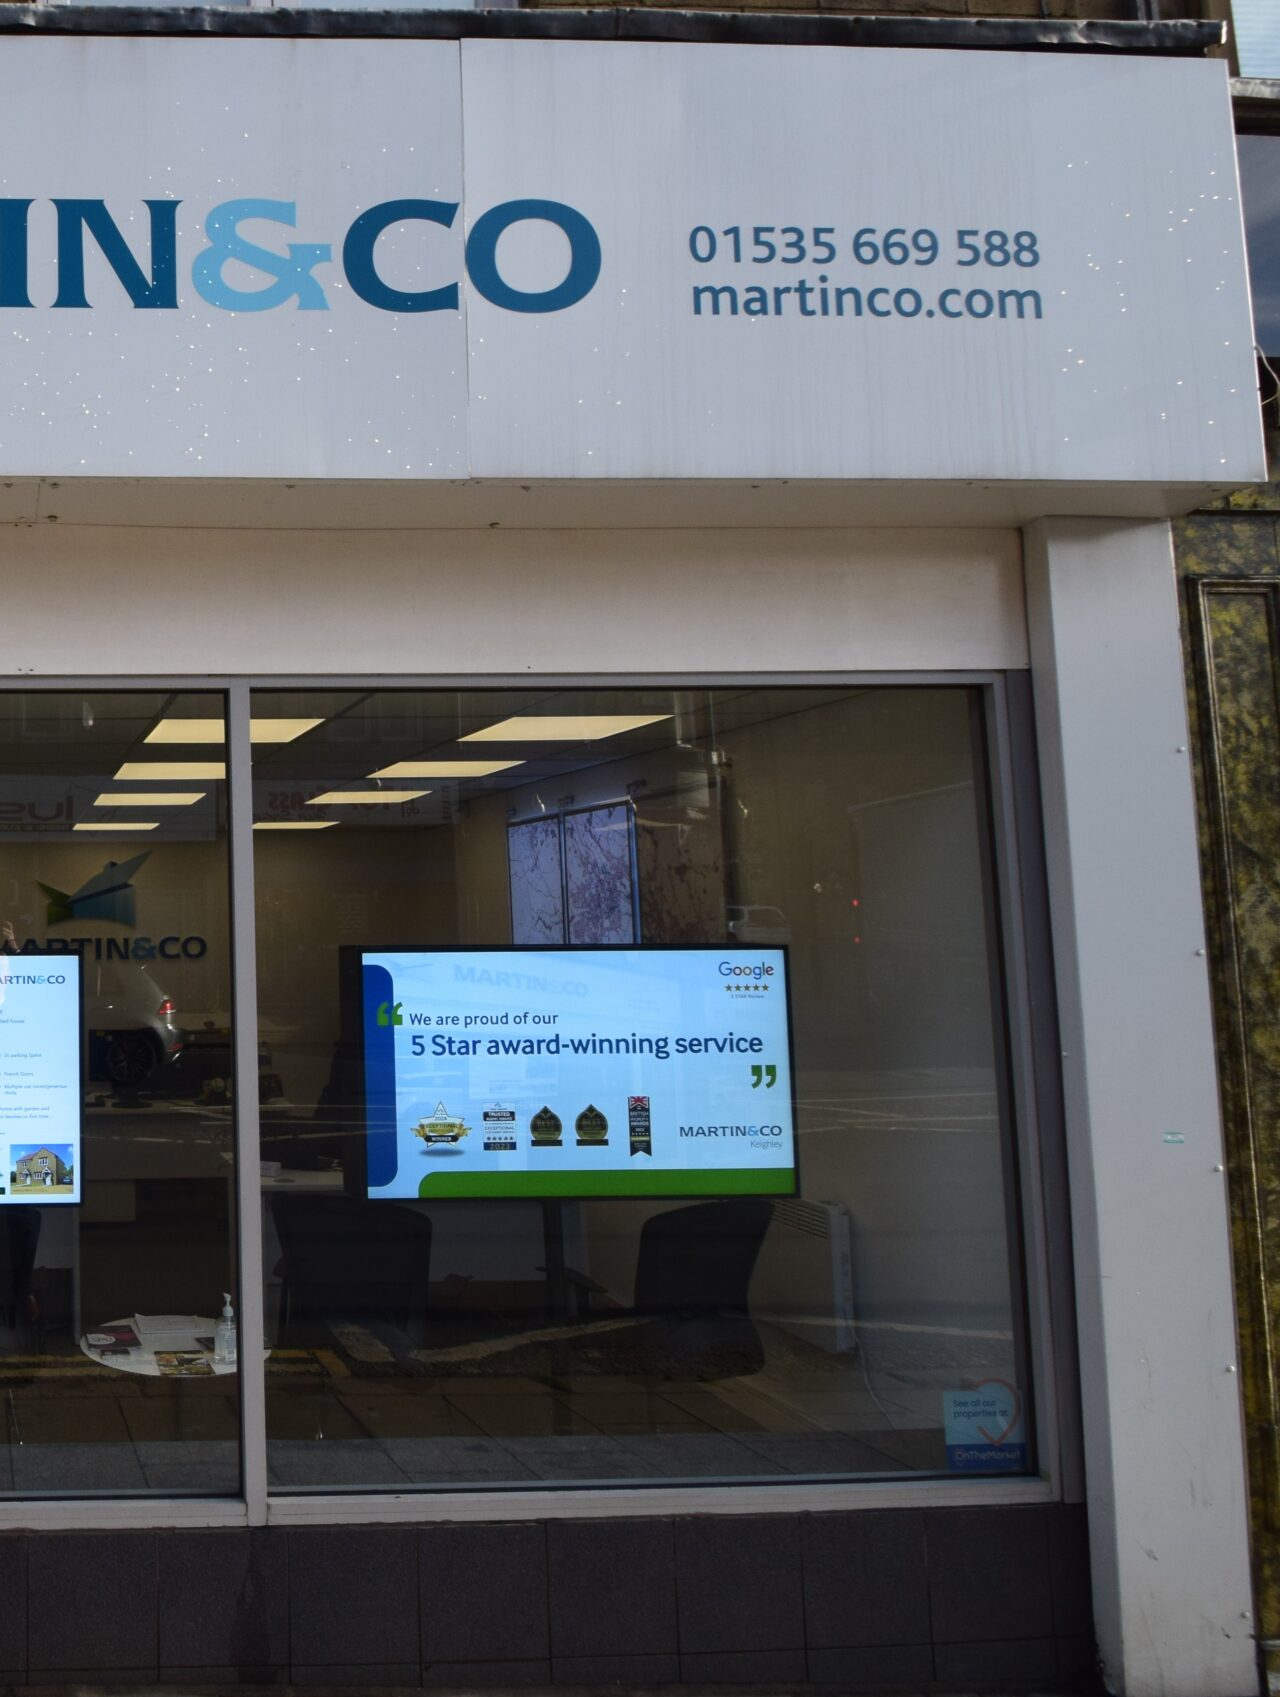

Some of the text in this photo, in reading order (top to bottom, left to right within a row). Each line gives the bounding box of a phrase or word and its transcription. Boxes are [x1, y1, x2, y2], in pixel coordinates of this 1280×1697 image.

[689, 225, 1040, 267] 01535 669 588
[692, 275, 1043, 319] martinco.com
[718, 961, 774, 980] Google
[410, 1011, 559, 1028] We are proud of our
[412, 1032, 763, 1059] 5 Star award-winning service
[679, 1125, 782, 1137] MARTIN&CO
[750, 1139, 783, 1151] Keighley
[952, 1399, 969, 1408] See
[970, 1399, 980, 1407] all
[954, 1409, 1009, 1420] properties at
